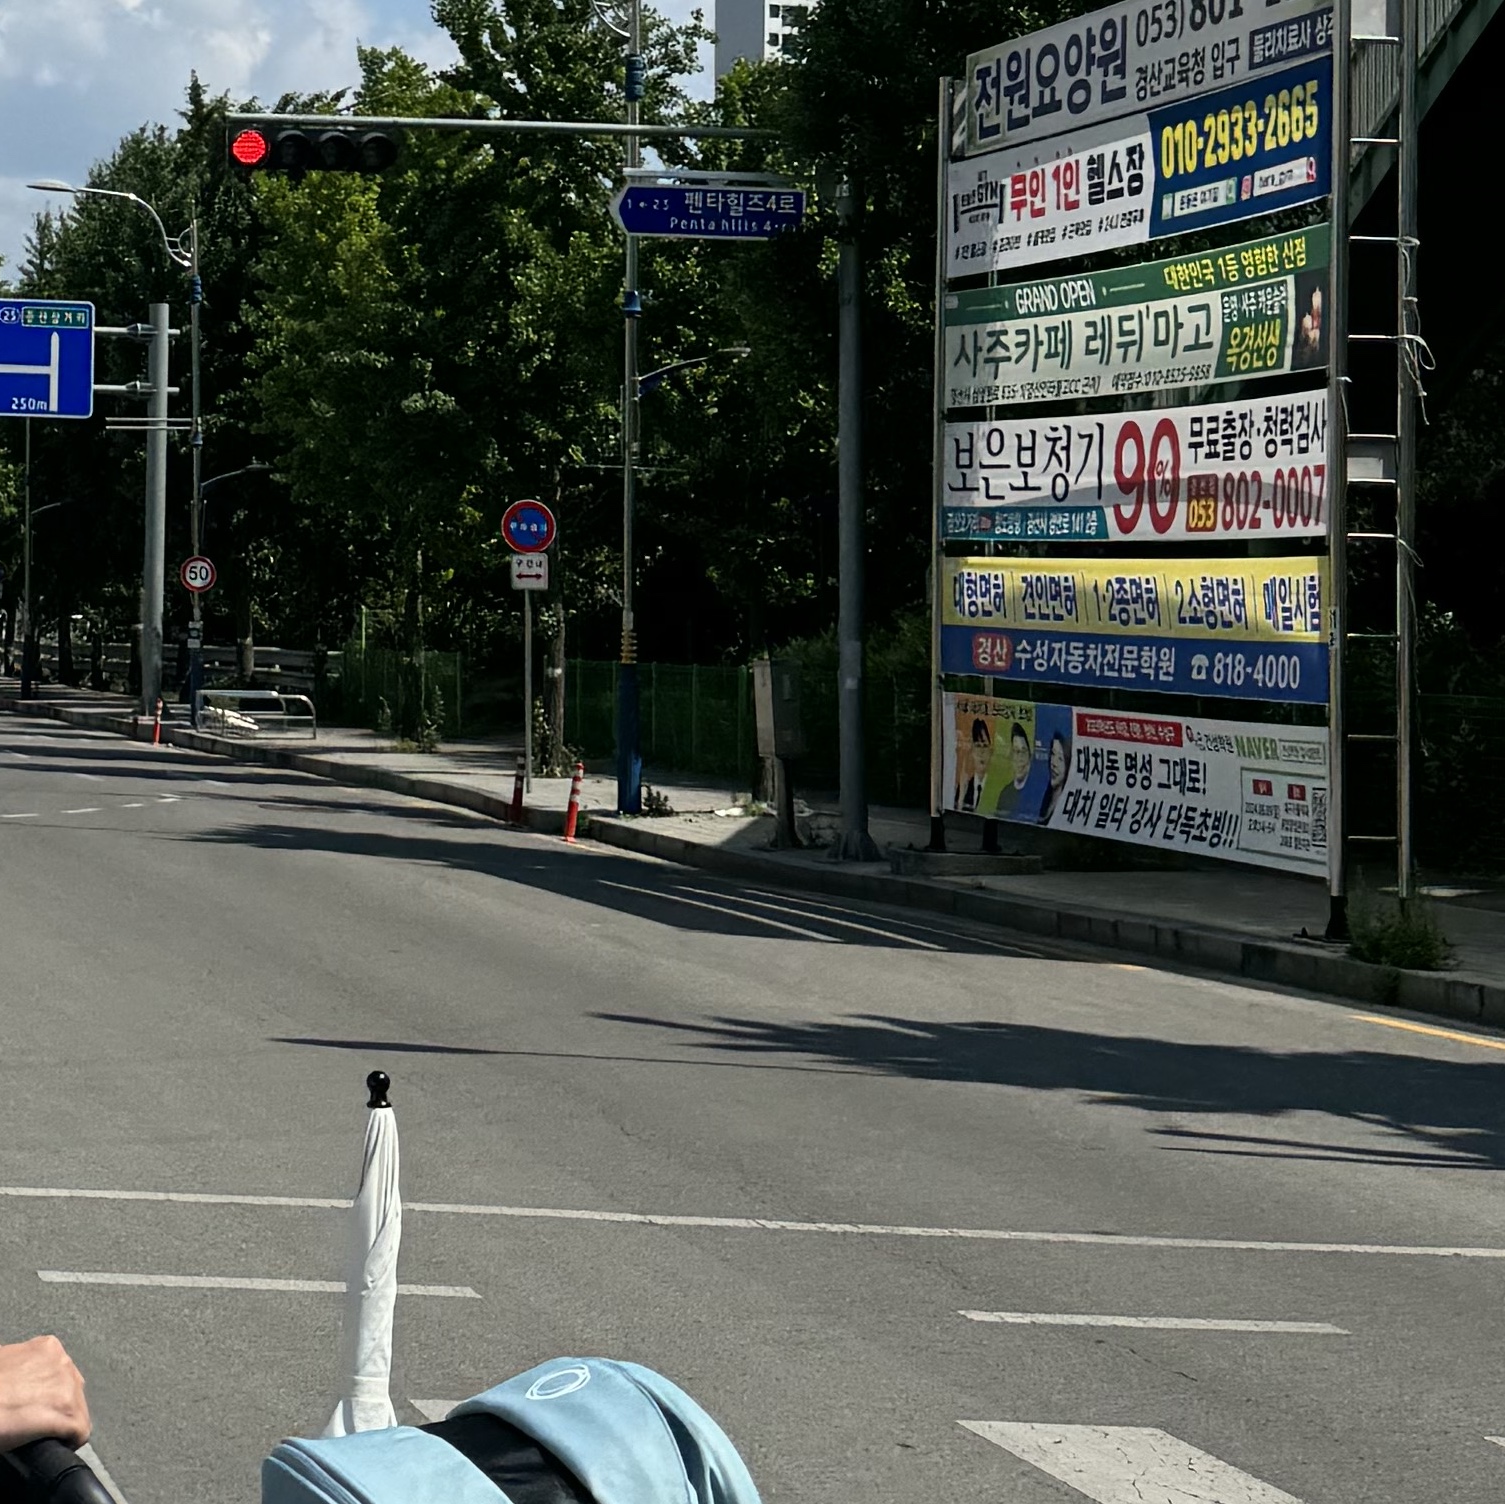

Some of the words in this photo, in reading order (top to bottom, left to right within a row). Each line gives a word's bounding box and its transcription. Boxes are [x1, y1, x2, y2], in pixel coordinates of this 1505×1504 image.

[1136, 46, 1205, 101] 경산교육청
[1211, 37, 1240, 80] 입구
[1253, 24, 1311, 64] 물리치료사
[975, 15, 1127, 140] 전원요양원
[1161, 80, 1318, 179] 010-2933-2665
[685, 191, 797, 216] 펜타힐즈4로
[1010, 168, 1046, 221] 무인
[1051, 159, 1080, 211] 1인
[1087, 143, 1145, 205] 헬스장
[670, 217, 716, 230] Penta
[721, 219, 758, 232] hills
[1164, 262, 1214, 290] 대한민국
[1217, 253, 1239, 282] 1등
[1241, 245, 1279, 278] 영험한
[1282, 236, 1306, 268] 신점
[2, 310, 16, 321] 25
[1015, 284, 1058, 314] GRAND
[1060, 279, 1097, 309] OPEN
[953, 319, 1073, 380] 사주카페
[11, 397, 47, 411] 250m
[1188, 398, 1326, 464] 무료출장·청력검사
[947, 422, 1104, 502] 보은보청기
[1188, 498, 1214, 529] 053
[1222, 464, 1325, 531] 802-0007
[954, 571, 1007, 618] 대형면허
[1021, 575, 1079, 623] 견인면허
[1175, 576, 1248, 630] 2소형면허
[1263, 576, 1321, 632] 매일시험
[978, 637, 1007, 666] 경산
[1015, 639, 1175, 682] 수성자동차전문학원
[1213, 652, 1300, 689] 818-4000
[1076, 746, 1120, 786] 대치동
[1124, 751, 1154, 791] 명성
[1157, 757, 1207, 796] 그대로!
[1234, 735, 1280, 760] NAVER
[1062, 788, 1096, 827] 대치
[1095, 793, 1129, 832] 일타
[1129, 799, 1164, 839] 강사
